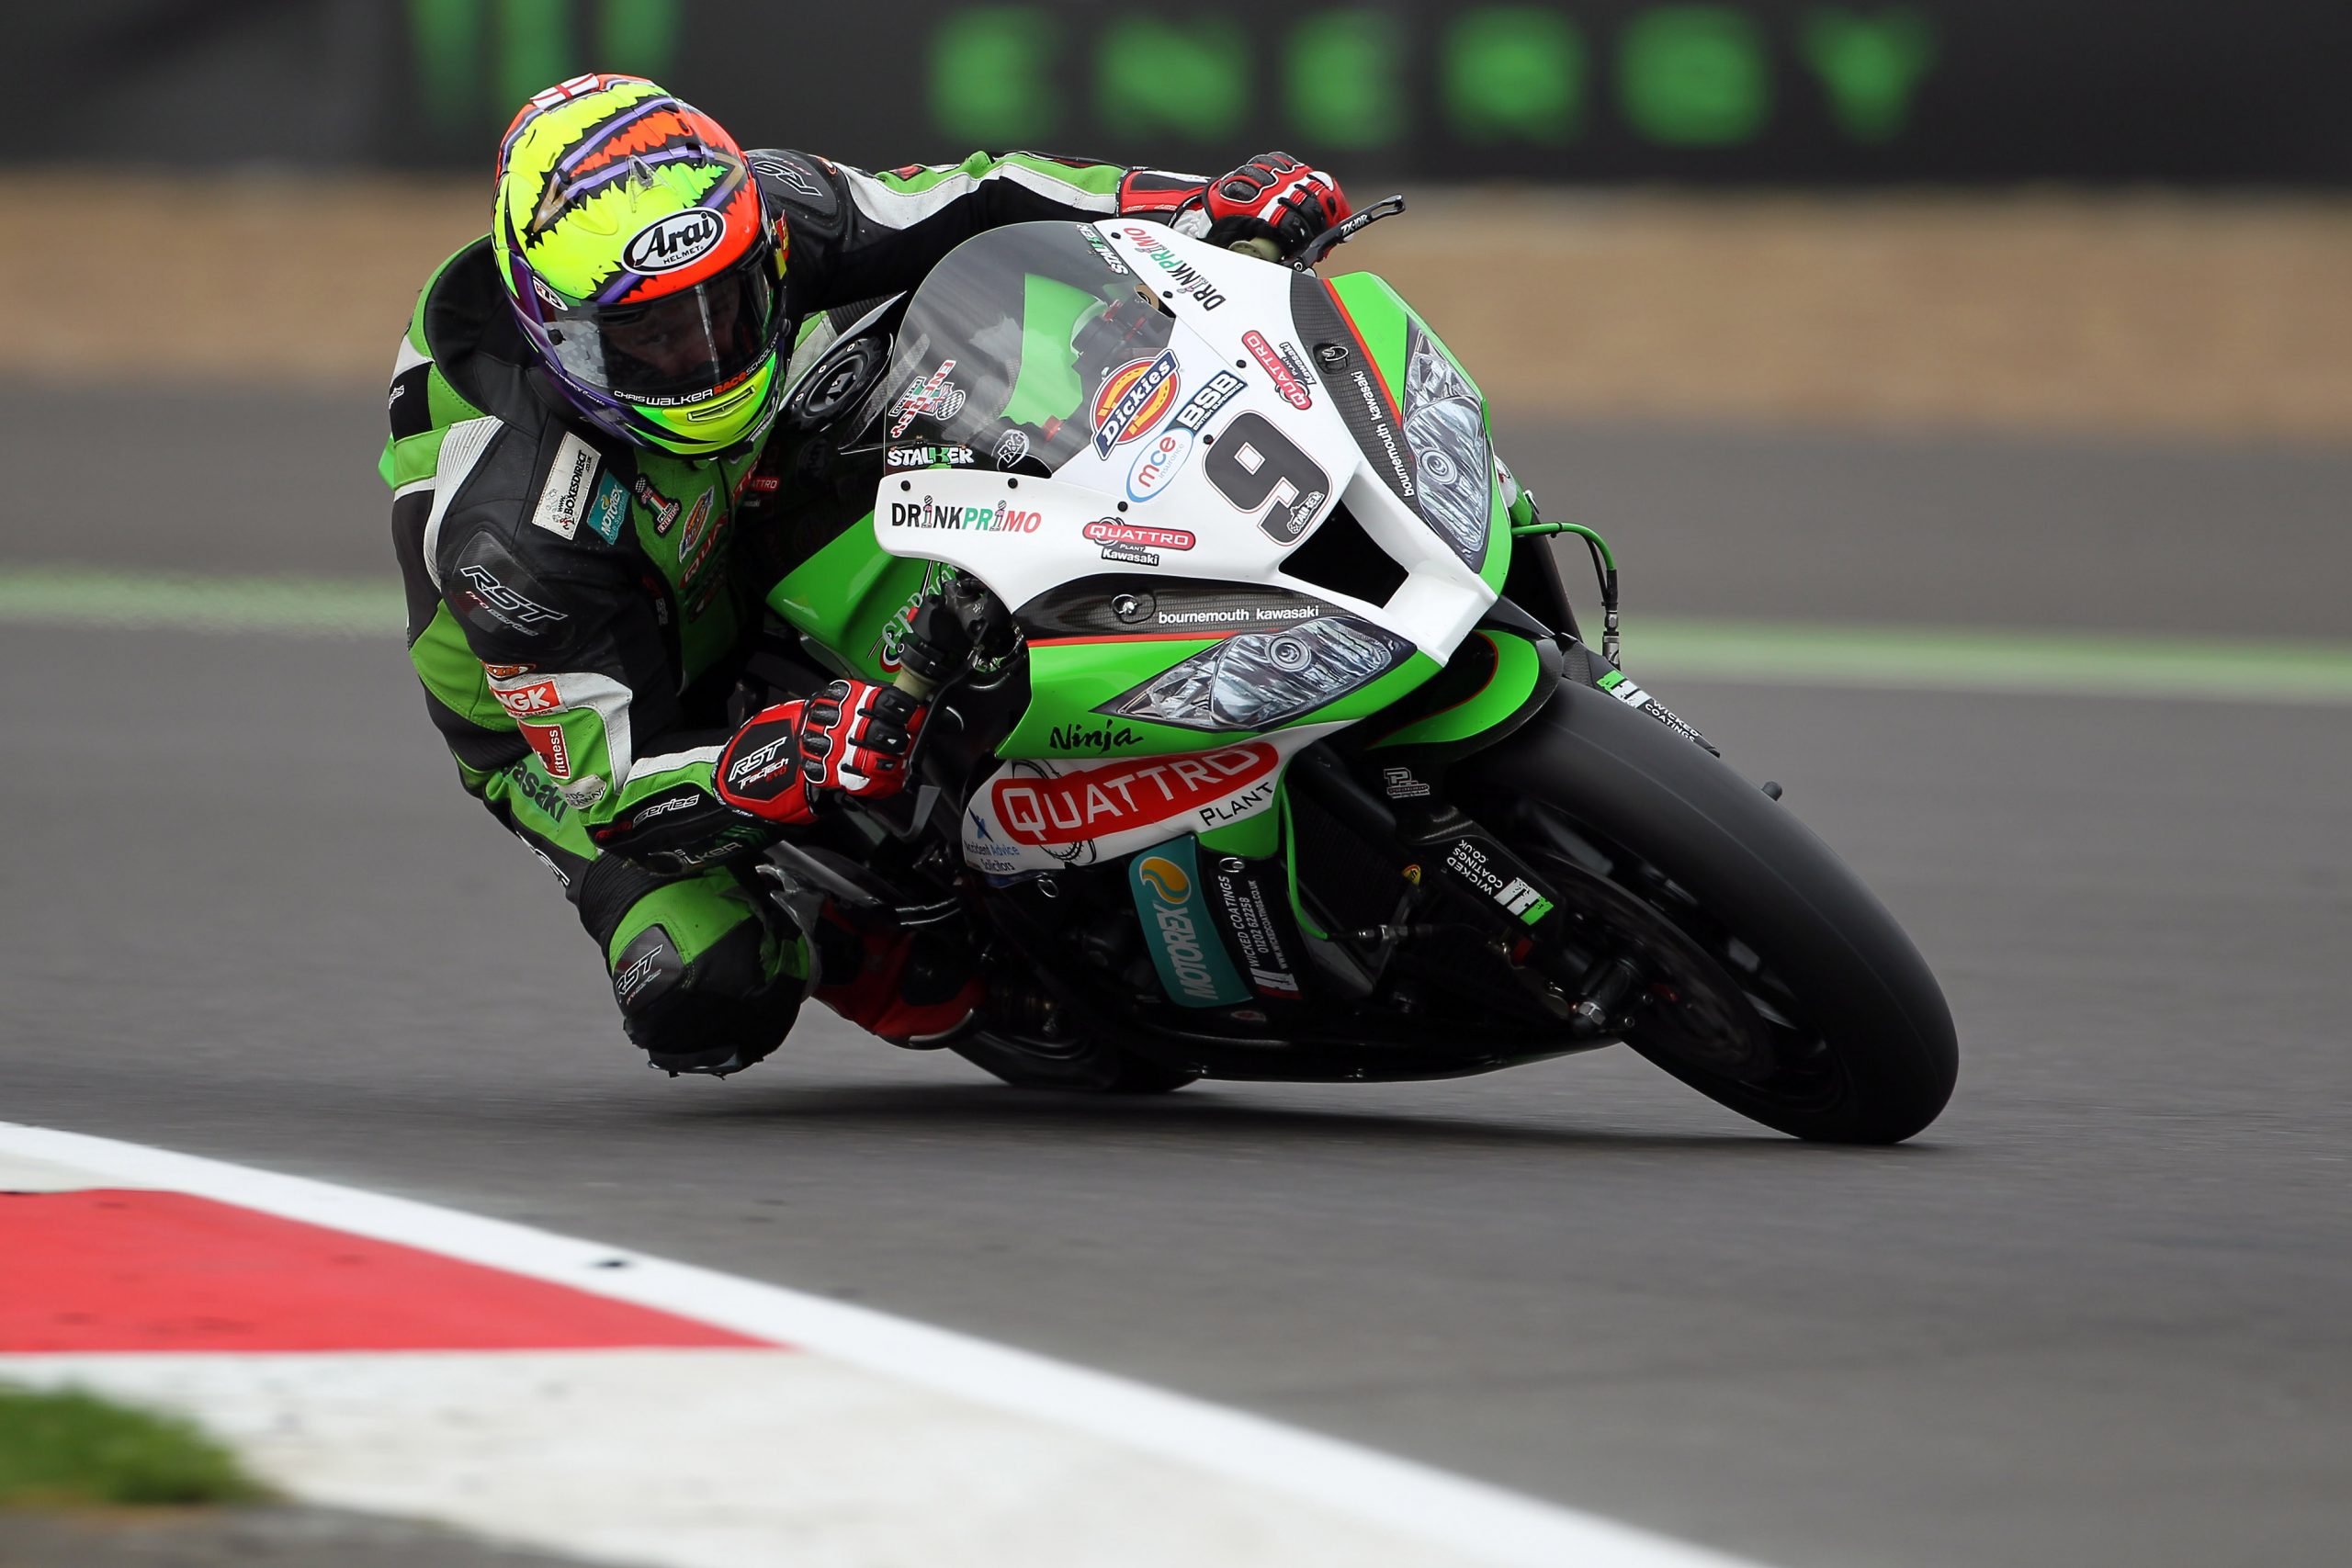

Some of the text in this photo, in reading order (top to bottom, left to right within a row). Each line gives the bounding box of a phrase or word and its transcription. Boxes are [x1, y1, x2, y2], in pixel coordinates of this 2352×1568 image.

[634, 212, 714, 267] Arai
[1340, 214, 1370, 236] ZX-10R
[663, 245, 700, 265] HELMET
[1247, 335, 1306, 406] QUATTRO
[1280, 342, 1316, 385] Kawasaki
[1283, 357, 1298, 377] PLANT
[1102, 360, 1170, 446] Dickies
[1175, 373, 1239, 429] BSB
[998, 432, 1026, 464] R&G
[1351, 370, 1415, 496] bournemouth kawasaki
[887, 446, 975, 467] STALKER
[1138, 436, 1176, 488] mce
[1159, 443, 1185, 479] insurance
[1204, 411, 1331, 545] 9
[601, 484, 623, 536] MOTOREX
[1089, 525, 1189, 547] QUATTRO
[1102, 548, 1159, 565] Kawasaki
[460, 565, 569, 623] RST
[1159, 605, 1319, 625] bournemouth kawasaki
[1049, 719, 1144, 754] Ninja
[1645, 703, 1696, 742] COATINGS
[1653, 700, 1699, 737] WICKED
[550, 729, 567, 773] fitness
[729, 736, 787, 782] RST
[1002, 750, 1261, 841] QUATTRO
[1199, 782, 1274, 827] PLANT
[1446, 856, 1493, 896] WICKED
[1453, 847, 1504, 888] COATINGS
[1217, 875, 1261, 967] WICKED COATINGS
[1250, 930, 1270, 953] 01202
[1152, 901, 1220, 1000] MOTOREX
